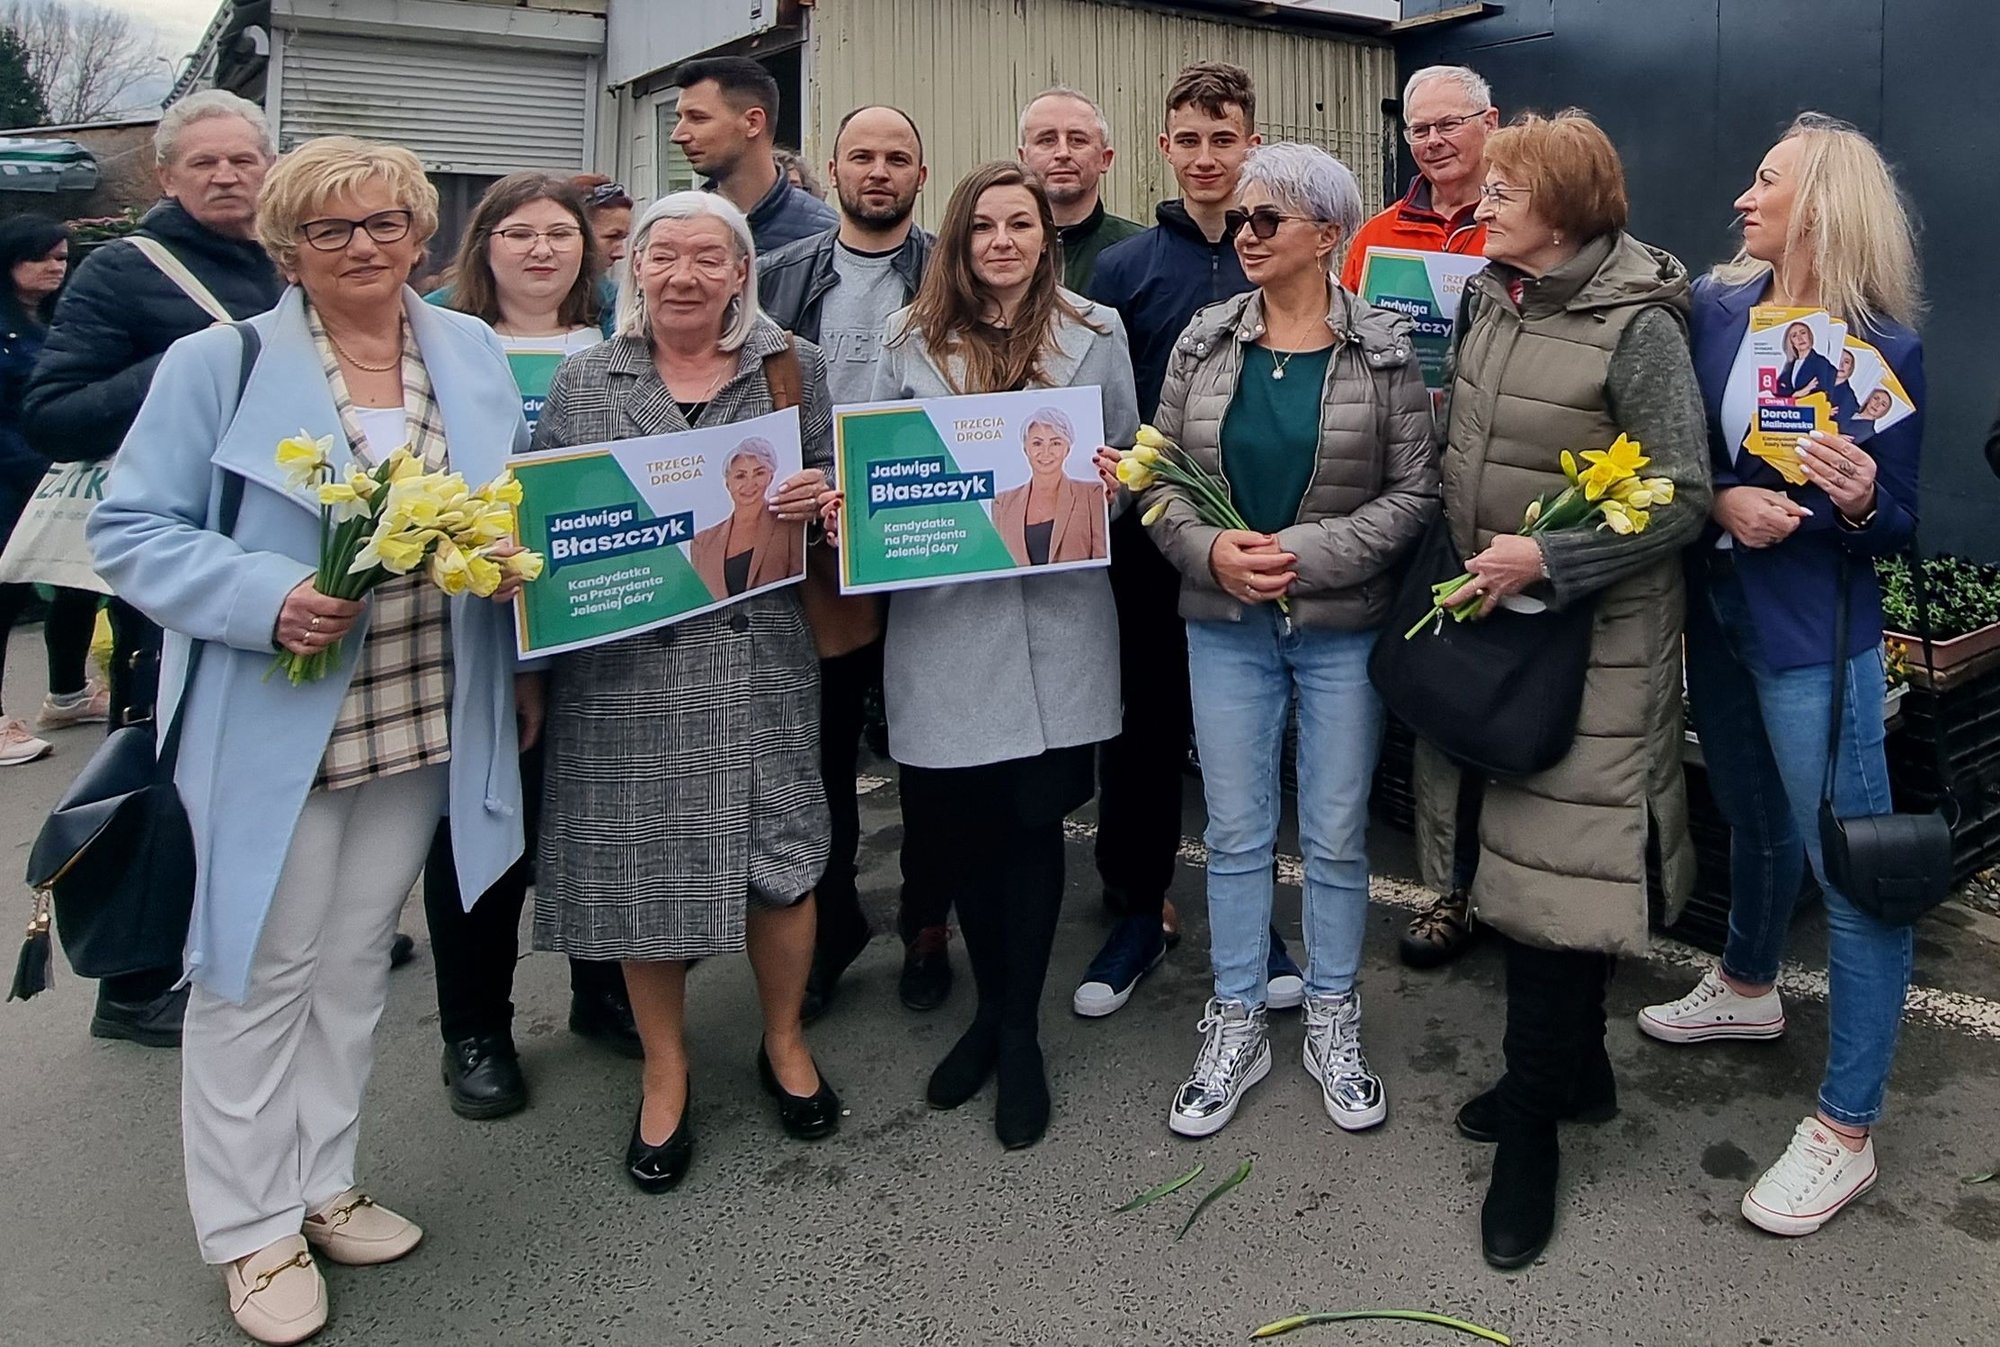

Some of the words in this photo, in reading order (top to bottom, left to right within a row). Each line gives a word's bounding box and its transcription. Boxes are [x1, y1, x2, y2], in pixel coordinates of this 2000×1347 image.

[1442, 274, 1463, 284] TRZE
[1443, 285, 1462, 294] DRO
[1763, 374, 1772, 388] 8
[1761, 409, 1800, 419] Dorota
[952, 417, 1005, 430] TRZECIA
[1761, 420, 1814, 429] Malinowska
[956, 429, 1003, 442] DROGA
[646, 454, 705, 473] TRZECIA
[871, 461, 941, 479] Jadwiga
[35, 466, 110, 501] ZATK
[651, 468, 703, 485] DROGA
[871, 475, 987, 503] Błaszczyk
[551, 509, 632, 532] Jadwiga
[884, 517, 955, 533] Kandydatka
[552, 519, 685, 559] Błaszczyk
[885, 536, 900, 545] na
[902, 528, 967, 545] Prezydenta
[885, 545, 929, 558] Jeleniej
[931, 542, 958, 554] Góry
[568, 565, 651, 591] Kandydatka
[569, 592, 588, 604] na
[589, 575, 664, 602] Prezydenta
[570, 594, 622, 618] Jeleniej
[624, 590, 655, 607] Góry
